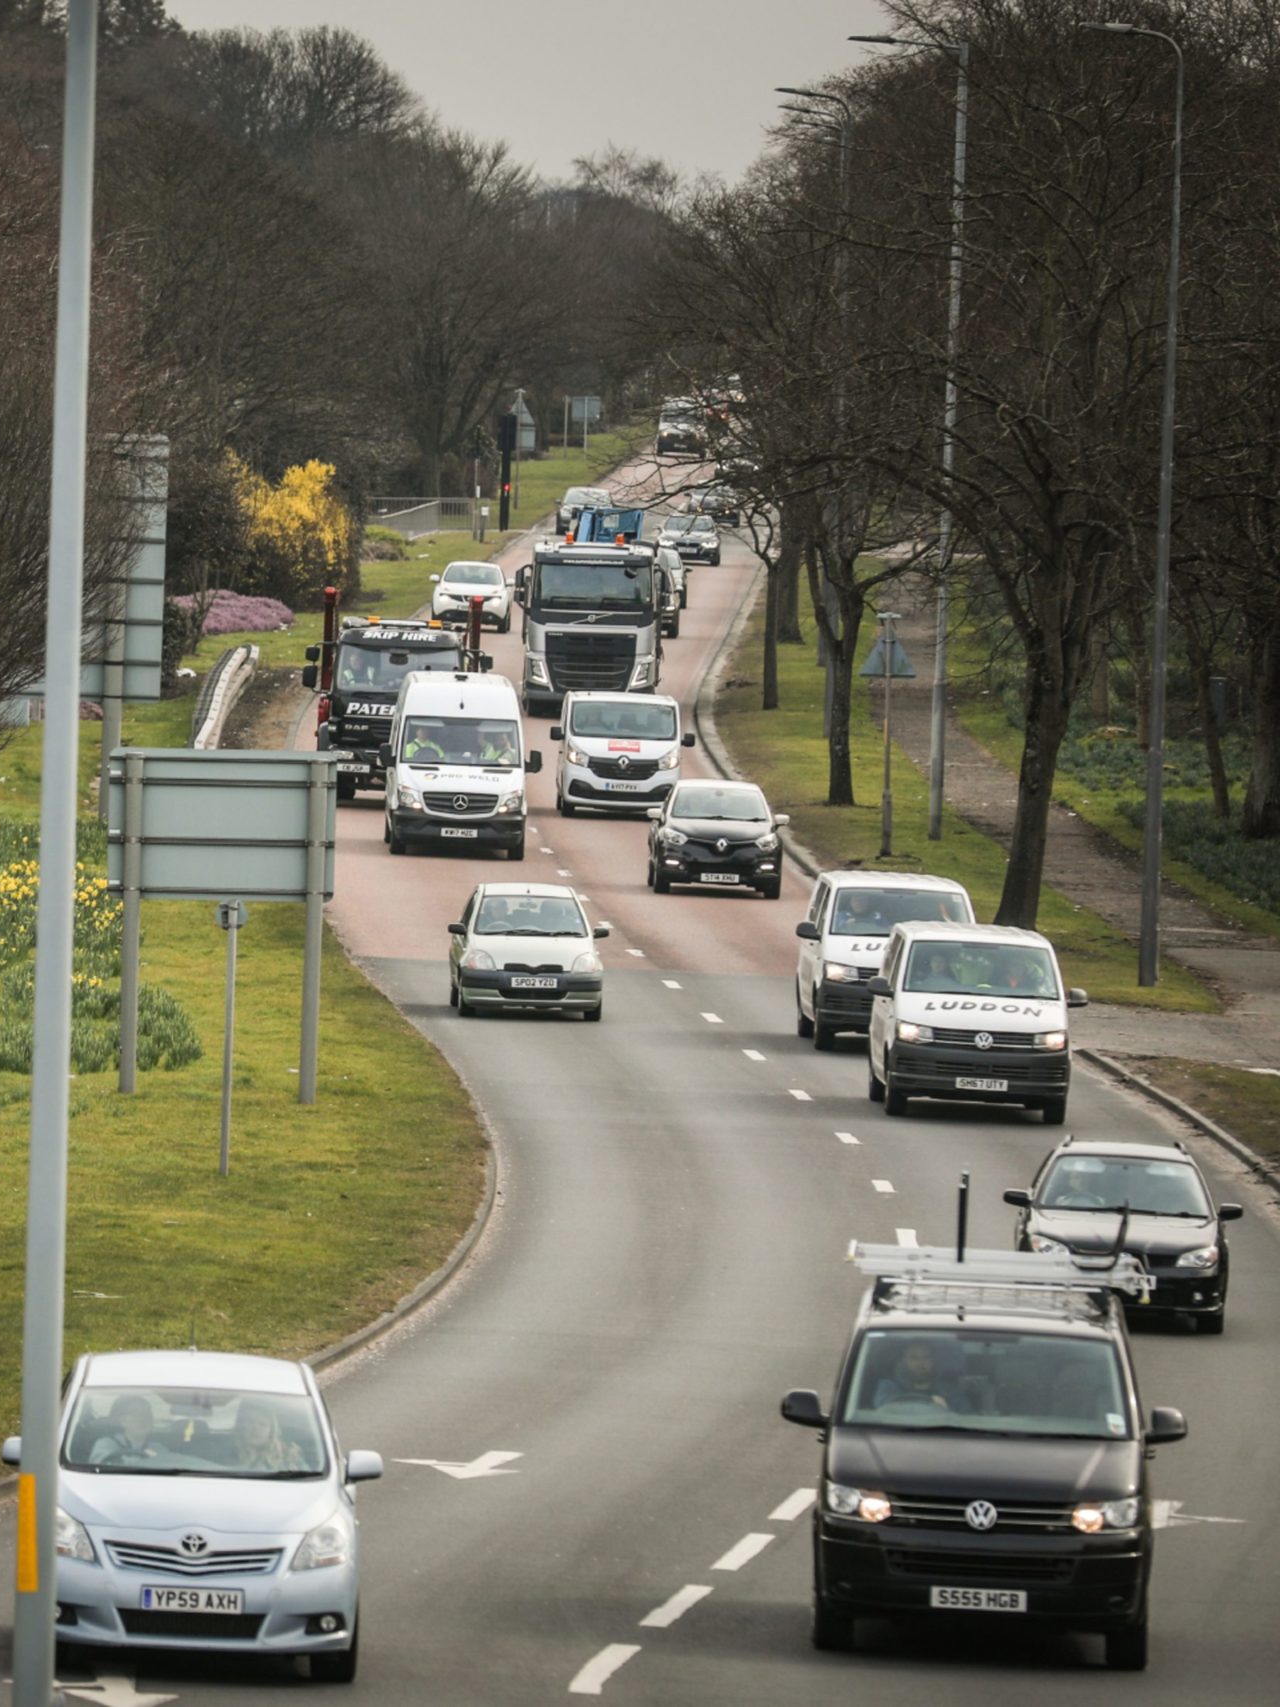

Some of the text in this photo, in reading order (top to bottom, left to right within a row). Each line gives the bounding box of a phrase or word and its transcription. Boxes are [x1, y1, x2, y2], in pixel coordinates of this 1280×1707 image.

[362, 631, 438, 642] SKIP HIRE
[850, 943, 889, 951] LU
[924, 1001, 1042, 1017] LUDDON
[155, 1590, 238, 1610] YP59 AXH
[938, 1589, 1020, 1608] S555 HGB
